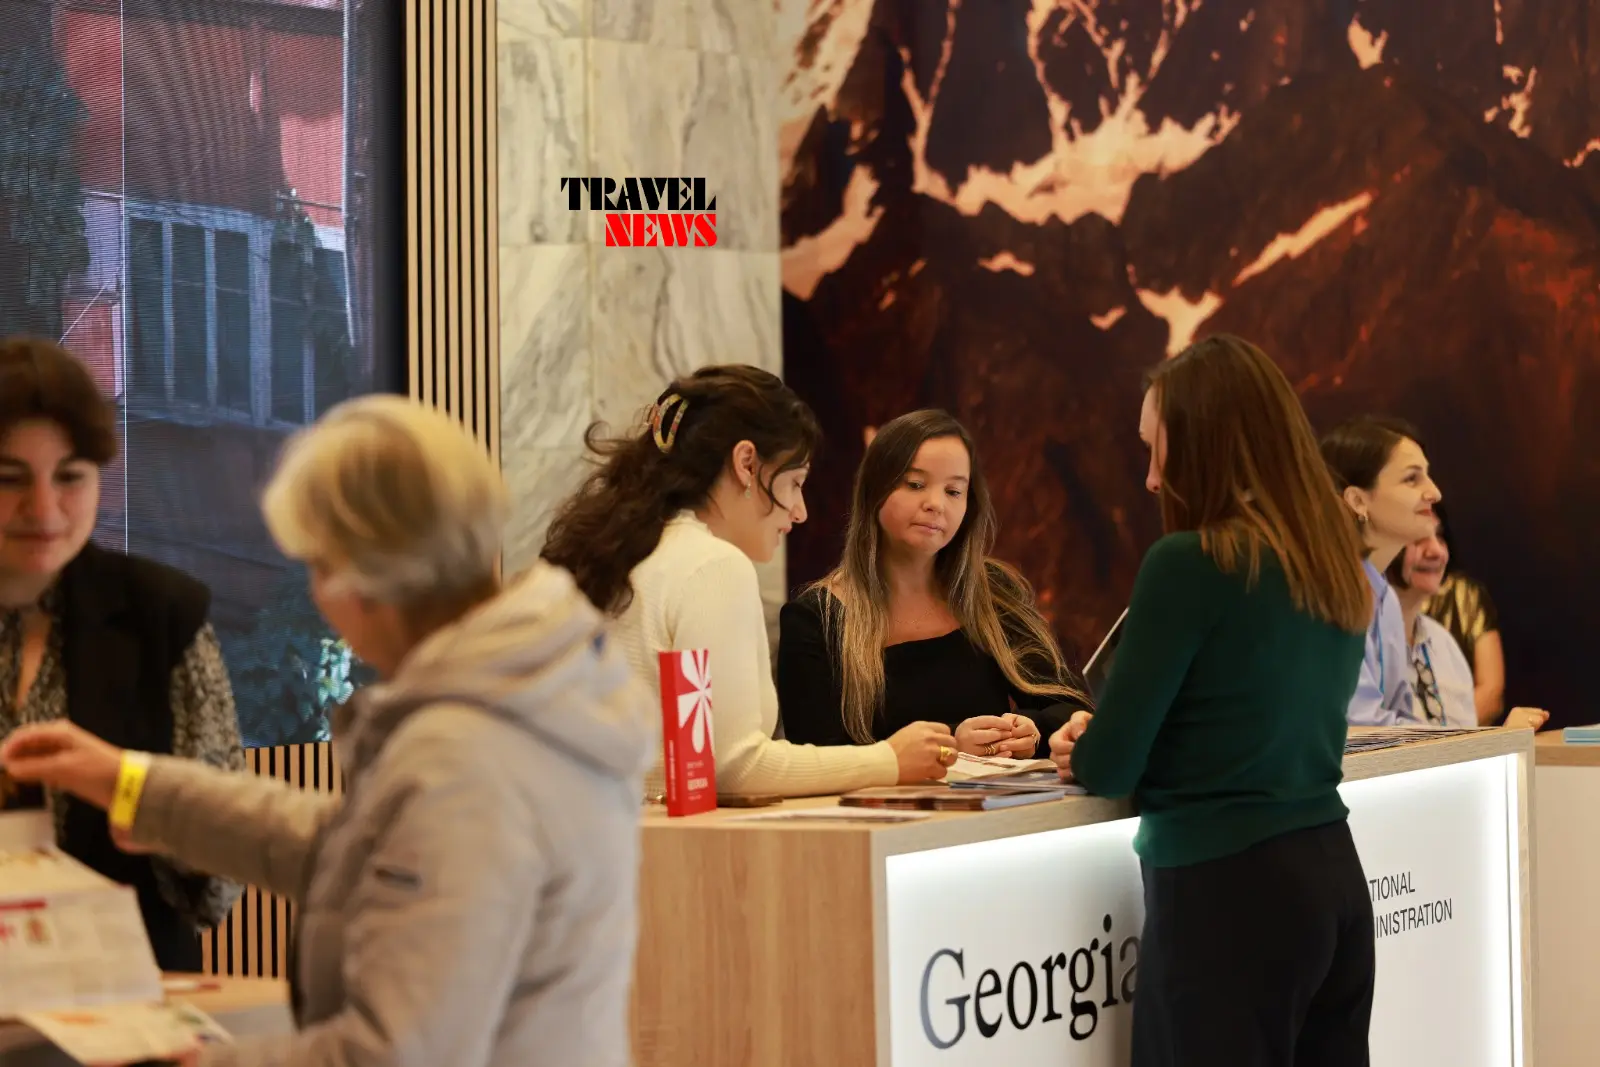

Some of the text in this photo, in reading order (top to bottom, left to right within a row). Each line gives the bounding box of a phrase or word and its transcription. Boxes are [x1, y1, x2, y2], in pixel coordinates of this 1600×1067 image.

[1369, 870, 1416, 902] TIONAL
[1376, 897, 1453, 939] INISTRATION
[919, 913, 1141, 1050] Georgia
